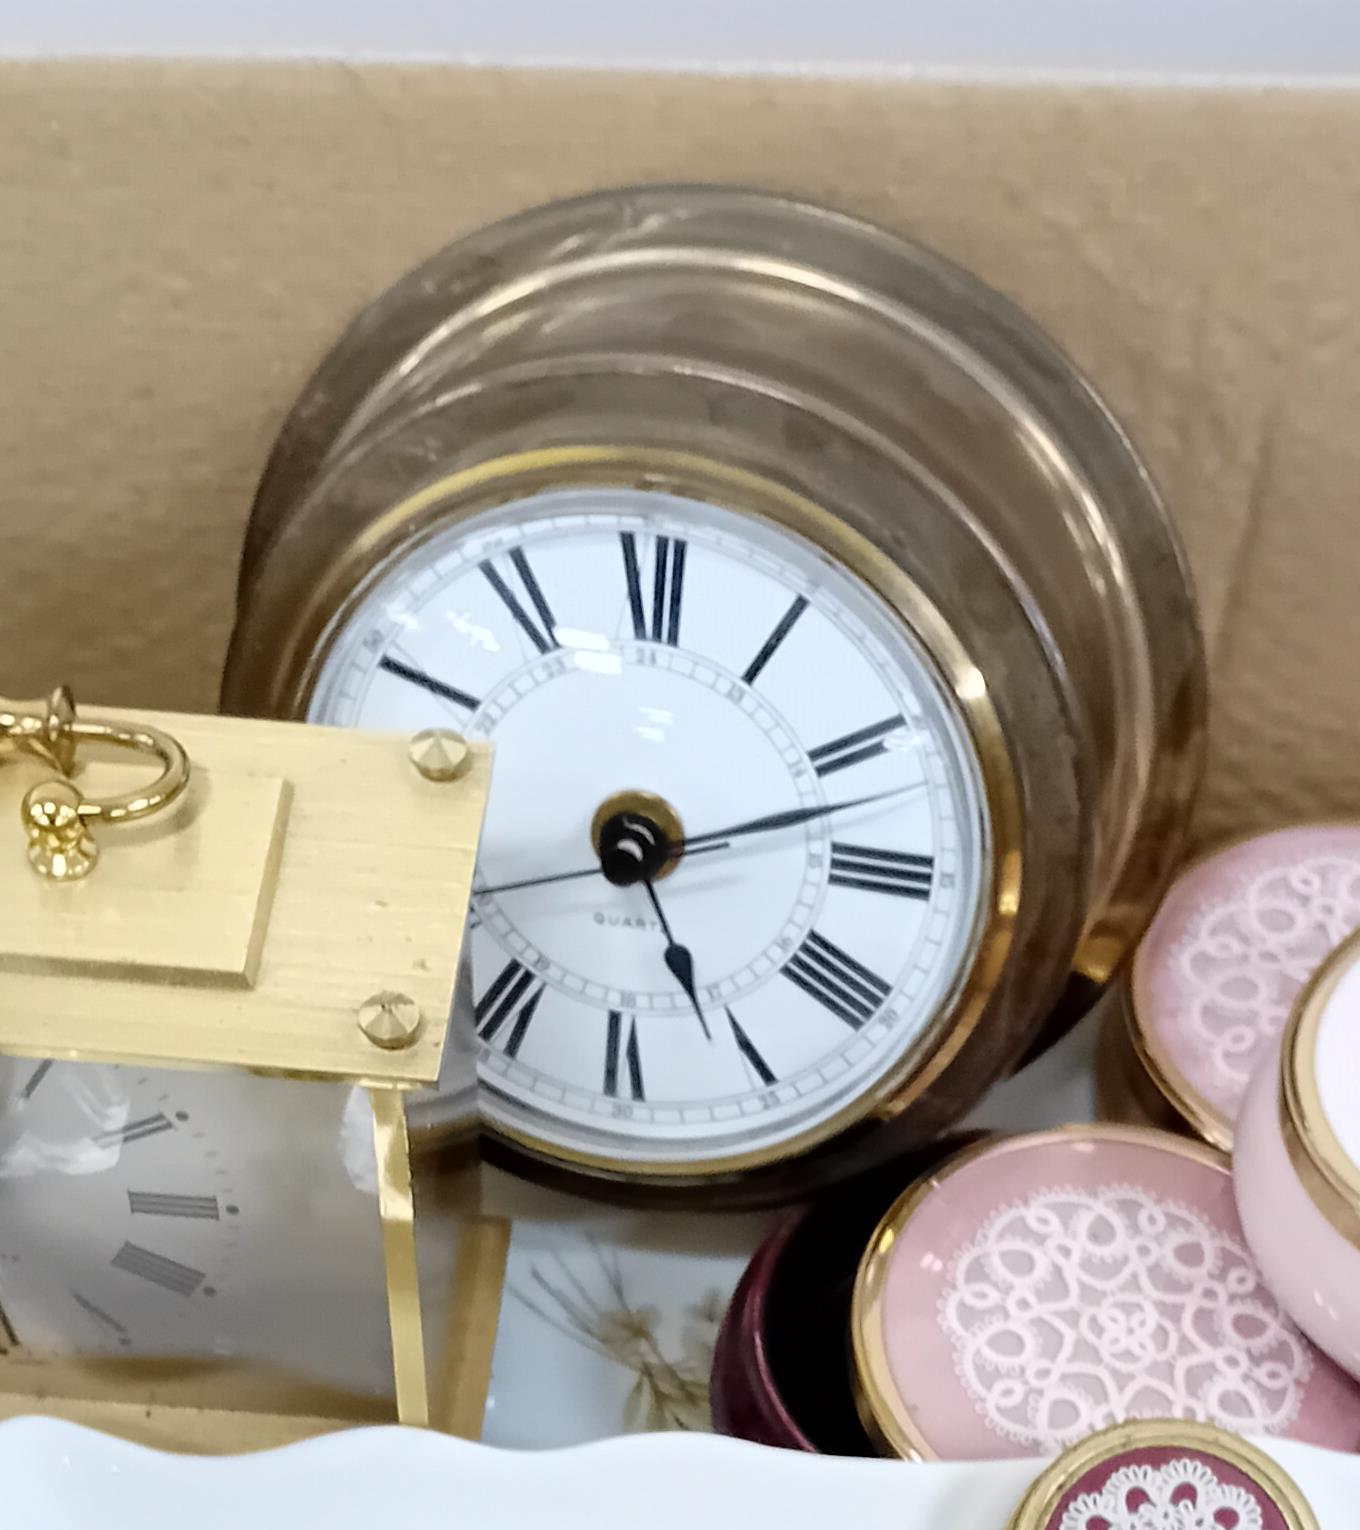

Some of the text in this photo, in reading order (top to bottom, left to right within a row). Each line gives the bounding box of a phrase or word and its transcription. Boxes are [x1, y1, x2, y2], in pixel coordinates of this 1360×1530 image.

[477, 545, 561, 656] XI
[615, 529, 688, 648] XII
[741, 593, 812, 686] I
[806, 713, 907, 778] II
[828, 841, 934, 901] III
[593, 911, 664, 935] QUART
[475, 958, 546, 1060] VII
[778, 928, 894, 1033] IIII
[602, 1007, 647, 1103] VI
[724, 1003, 779, 1088] V
